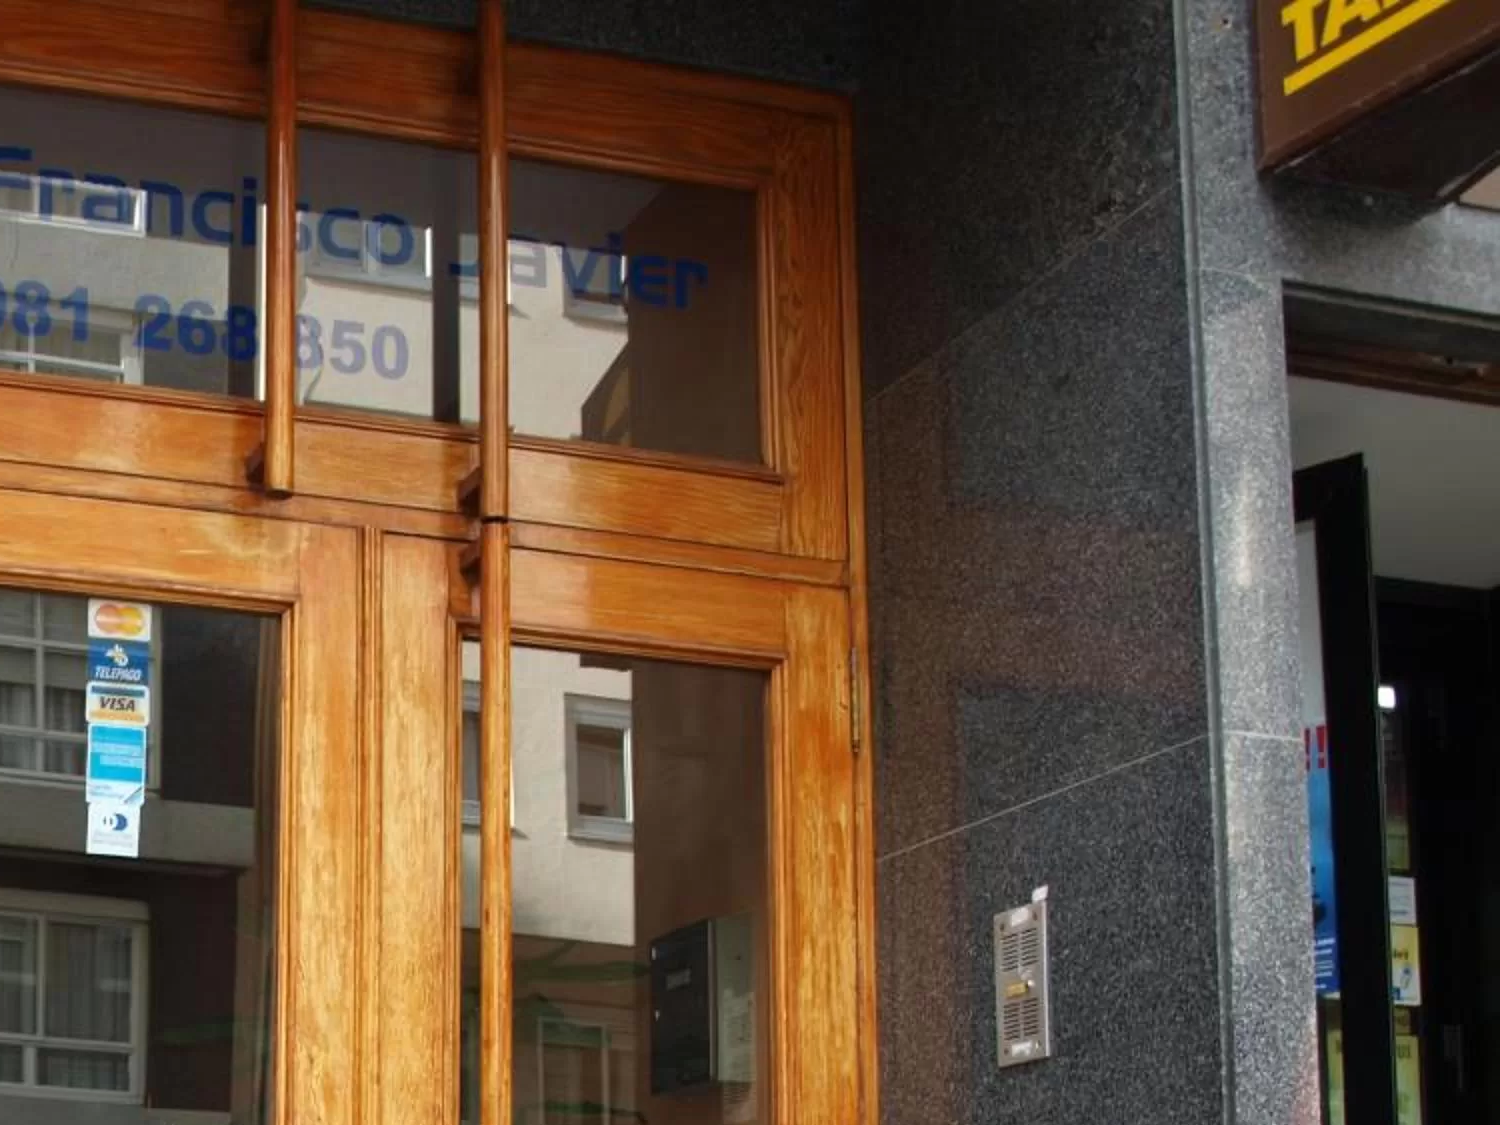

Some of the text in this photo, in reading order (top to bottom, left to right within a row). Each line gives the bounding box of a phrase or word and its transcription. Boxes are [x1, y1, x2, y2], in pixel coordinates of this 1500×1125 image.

[1282, 0, 1400, 63] TA
[133, 294, 258, 361] 268
[295, 313, 410, 380] 850
[100, 696, 135, 712] VISA
